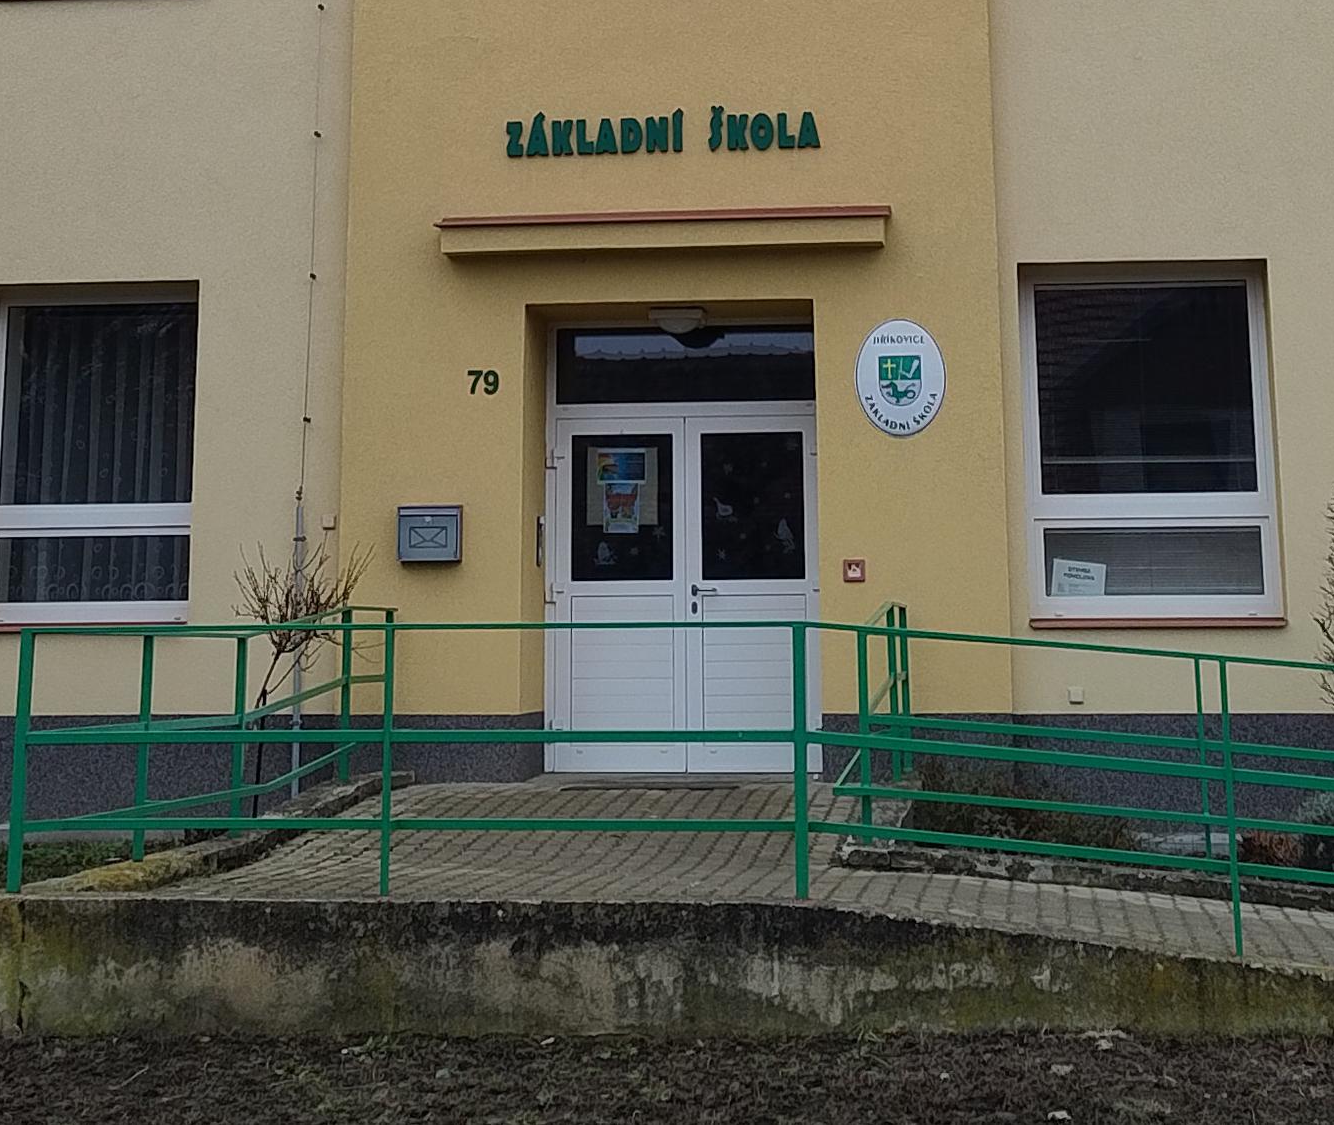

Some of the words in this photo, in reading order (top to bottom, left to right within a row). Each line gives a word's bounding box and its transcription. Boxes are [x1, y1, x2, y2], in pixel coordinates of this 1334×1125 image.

[506, 109, 684, 157] ZÁKLADNÍ
[708, 105, 821, 152] ŠKOLA
[467, 370, 499, 395] 79
